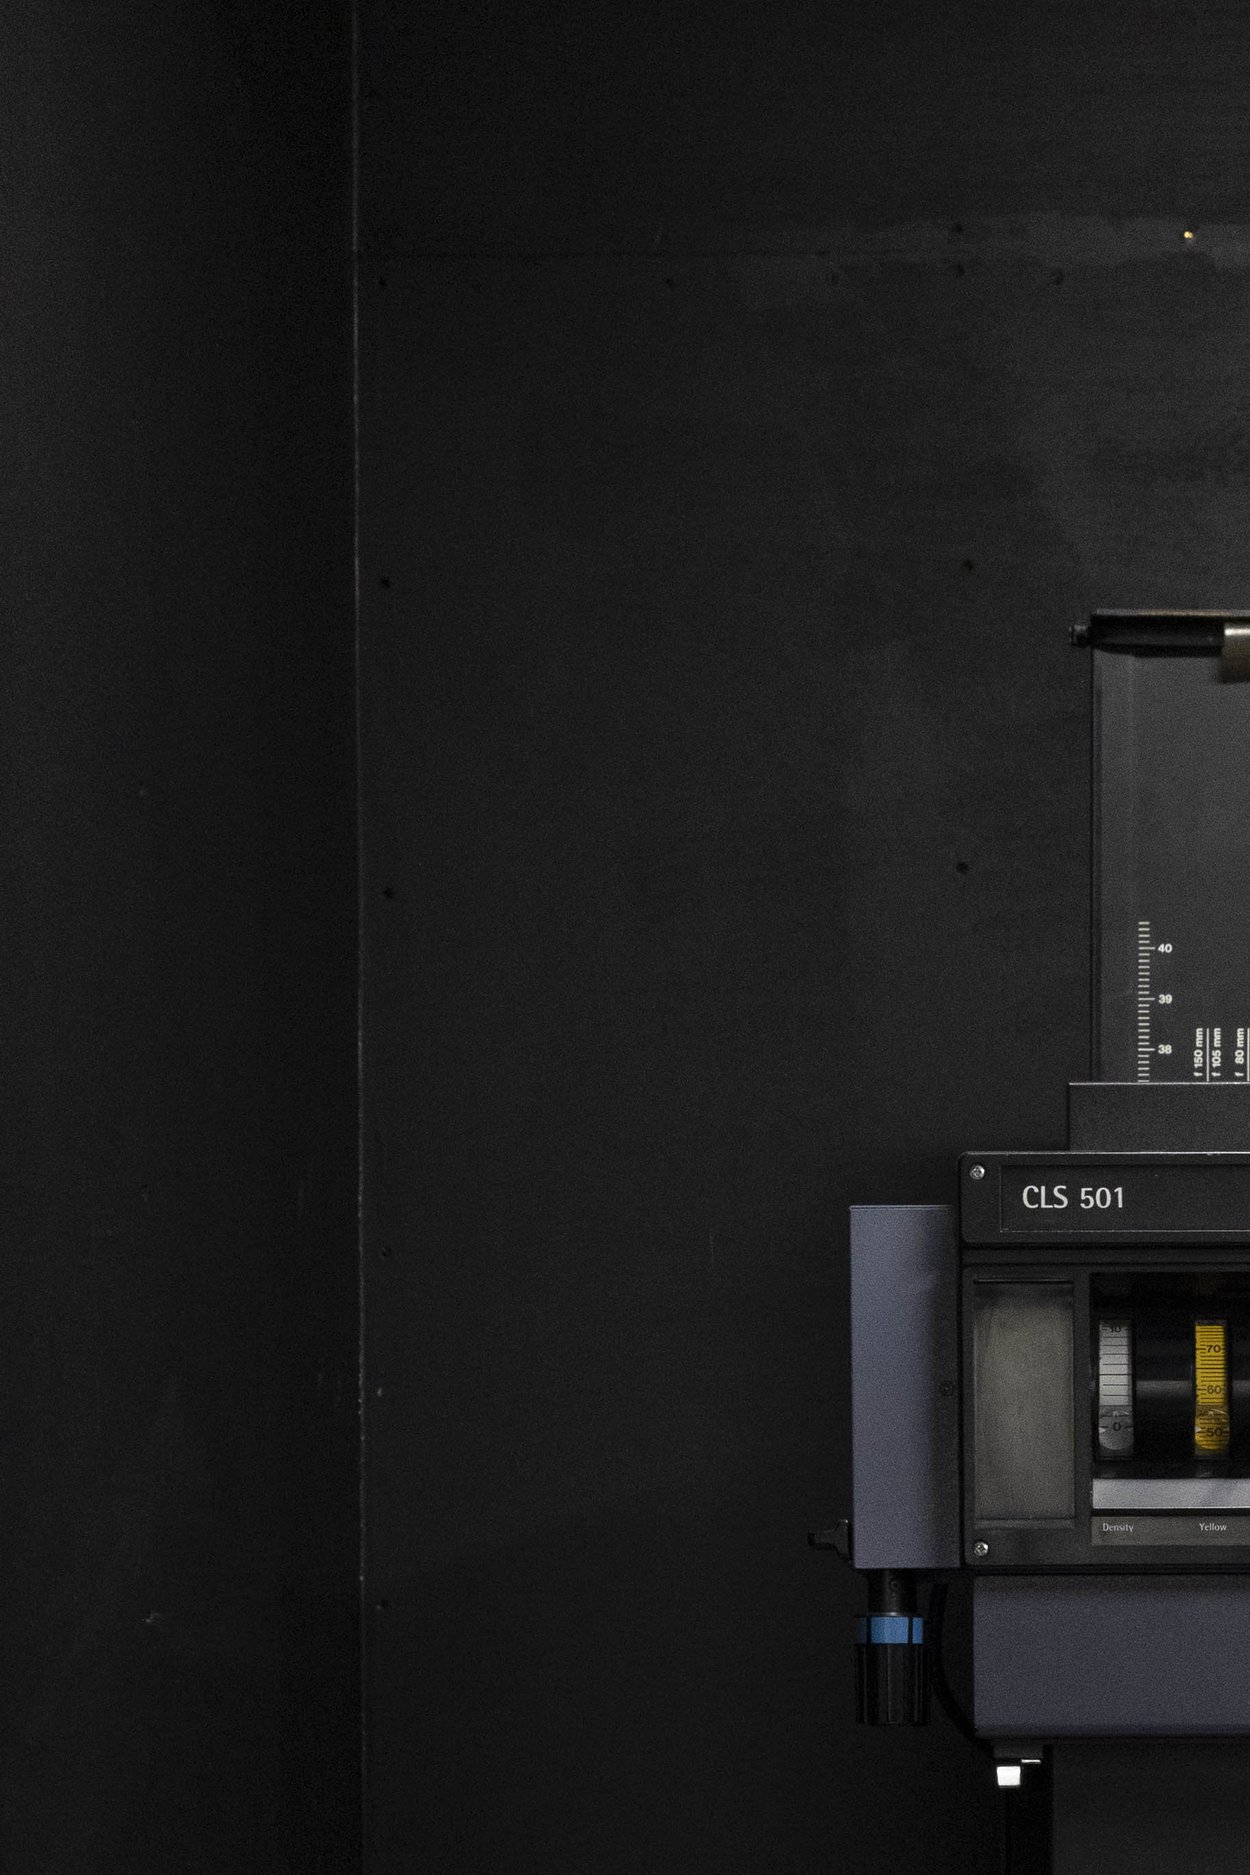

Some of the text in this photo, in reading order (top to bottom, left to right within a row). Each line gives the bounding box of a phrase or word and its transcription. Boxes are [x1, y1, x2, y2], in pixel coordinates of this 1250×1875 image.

[1158, 944, 1172, 953] 40
[1159, 994, 1172, 1004] 39
[1196, 1028, 1203, 1047] mm
[1214, 1028, 1221, 1047] mm
[1237, 1028, 1244, 1047] mm
[1159, 1045, 1171, 1054] 38
[1194, 1050, 1203, 1068] 150
[1212, 1050, 1221, 1067] 105
[1235, 1050, 1244, 1064] 80
[1023, 1185, 1122, 1208] CLS 501
[1206, 1344, 1221, 1354] 70
[1206, 1384, 1223, 1394] 60
[1112, 1421, 1121, 1432] 0
[1206, 1426, 1223, 1437] 50
[1103, 1523, 1133, 1532] Density
[1199, 1523, 1226, 1531] Yellow
